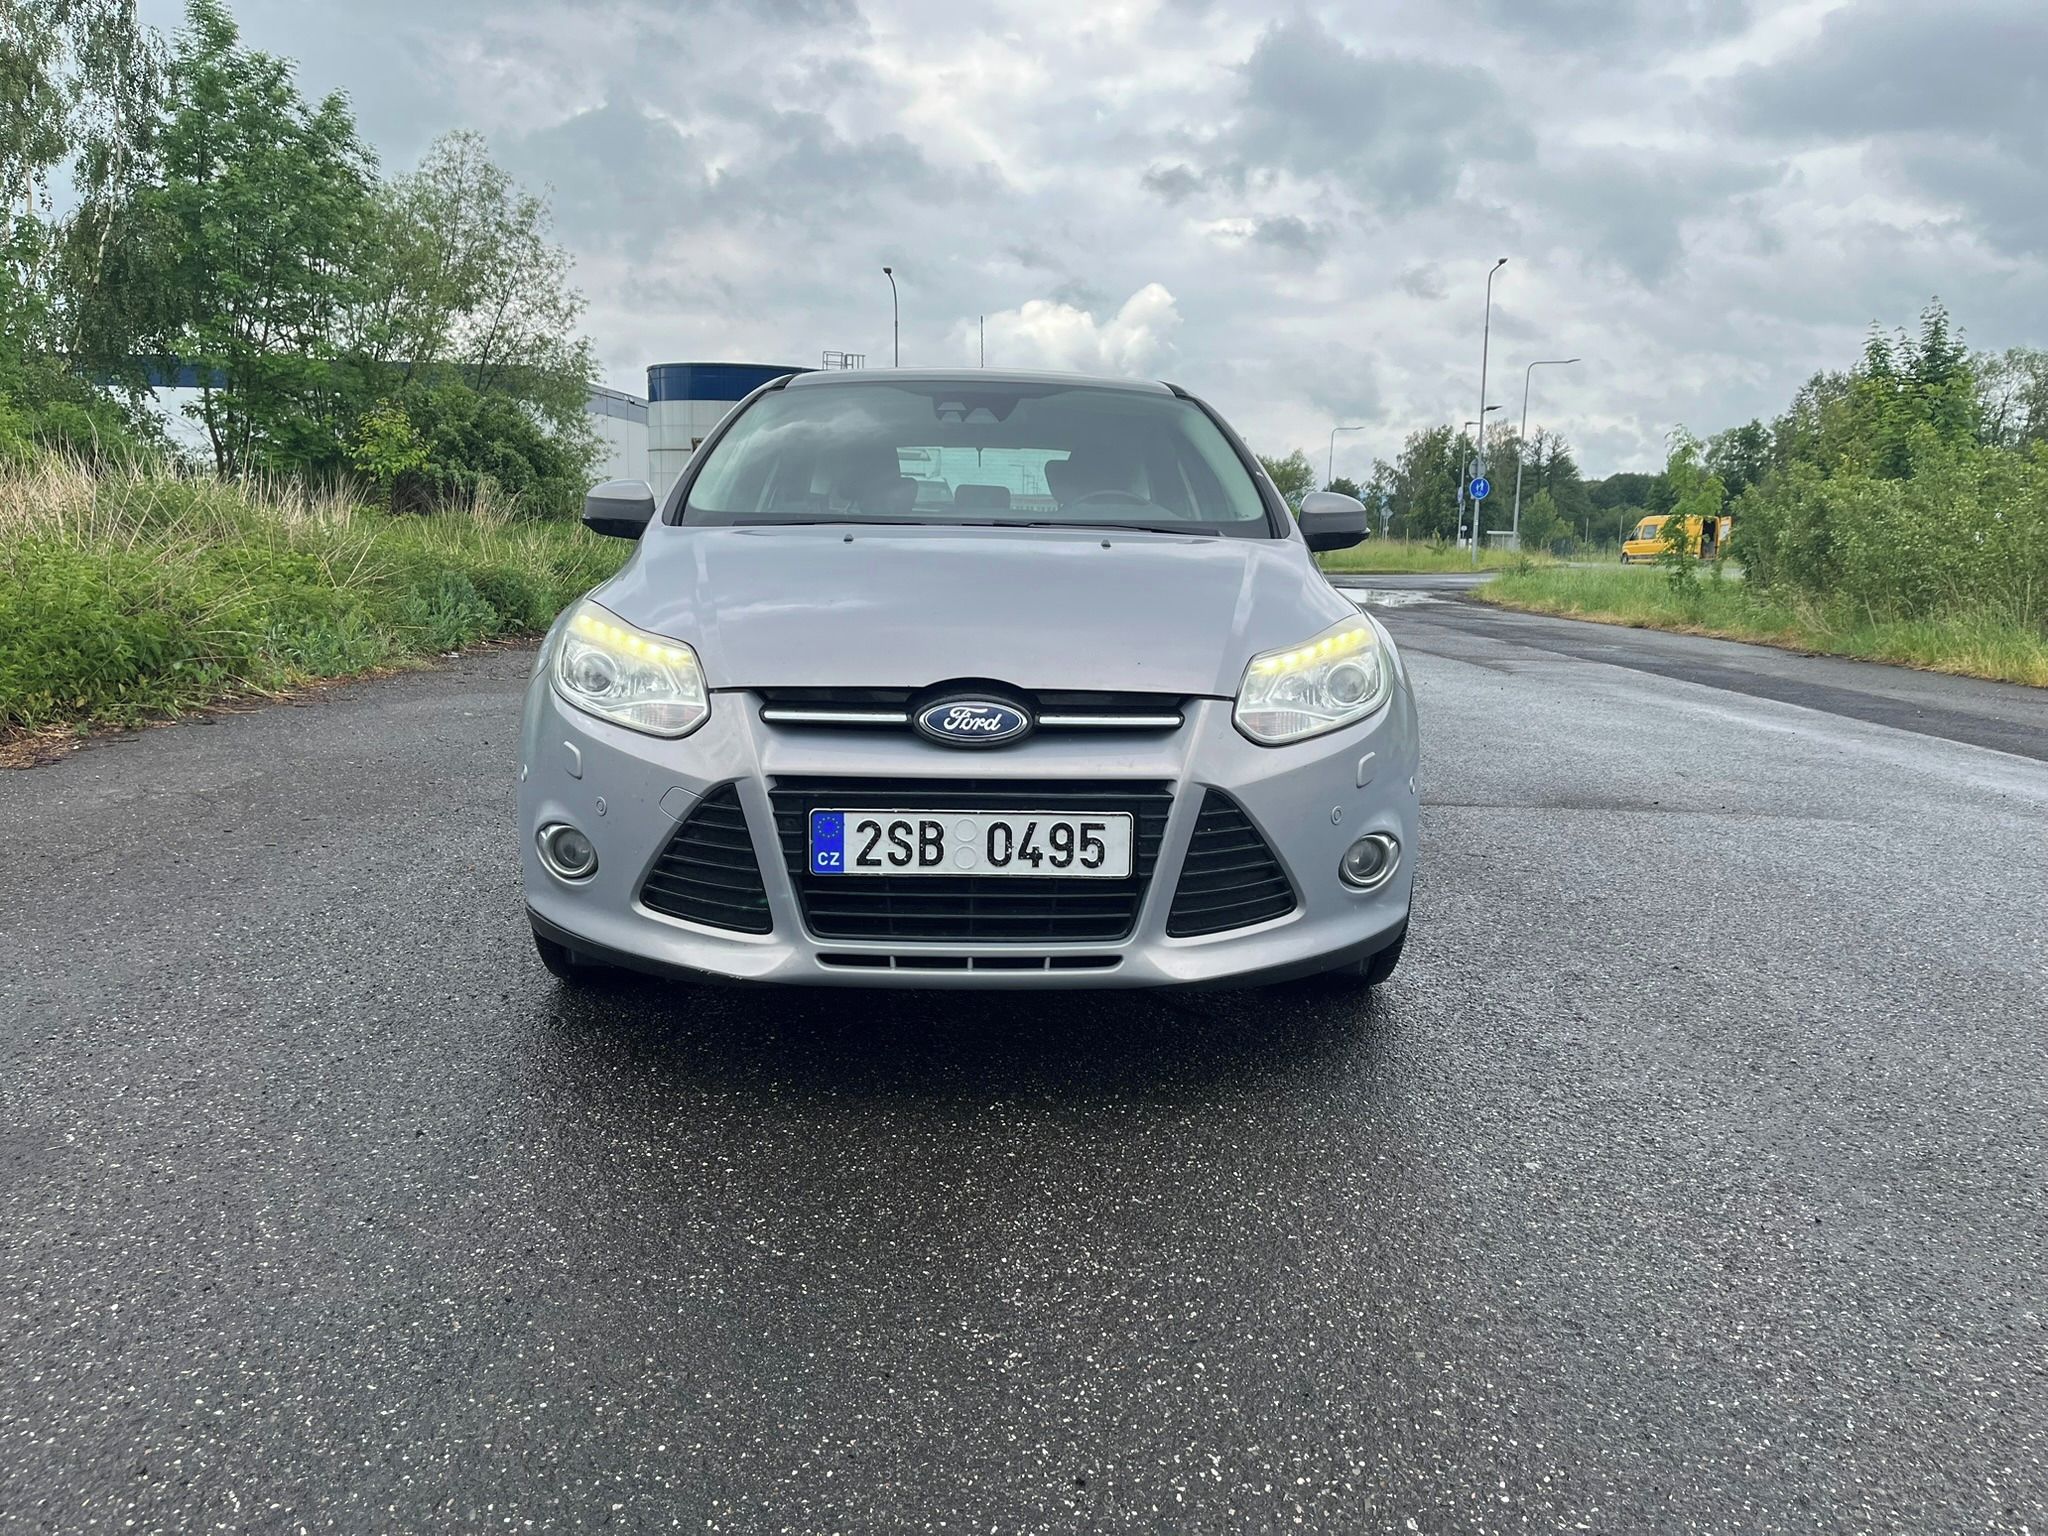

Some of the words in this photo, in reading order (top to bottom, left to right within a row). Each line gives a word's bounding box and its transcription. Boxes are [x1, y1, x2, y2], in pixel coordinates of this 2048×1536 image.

[943, 706, 1002, 732] Ford
[856, 819, 945, 867] 2SB
[986, 821, 1106, 868] 0495
[817, 851, 840, 866] CZ
